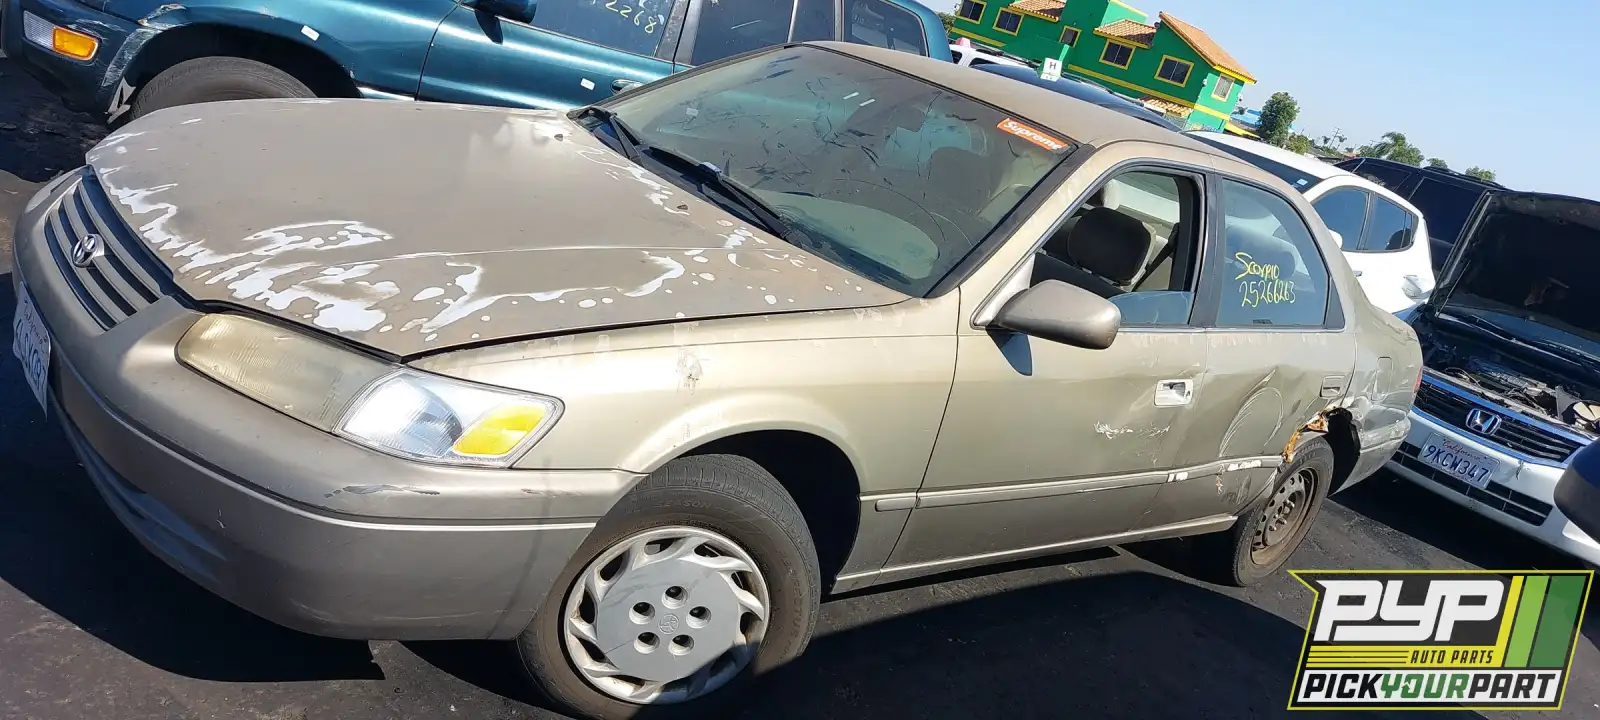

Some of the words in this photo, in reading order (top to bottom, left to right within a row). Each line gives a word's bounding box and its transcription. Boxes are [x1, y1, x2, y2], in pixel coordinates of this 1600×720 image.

[1003, 121, 1062, 150] Supreme
[1239, 279, 1296, 308] 25266263
[1423, 445, 1489, 482] 9KCW347
[1442, 440, 1482, 461] California
